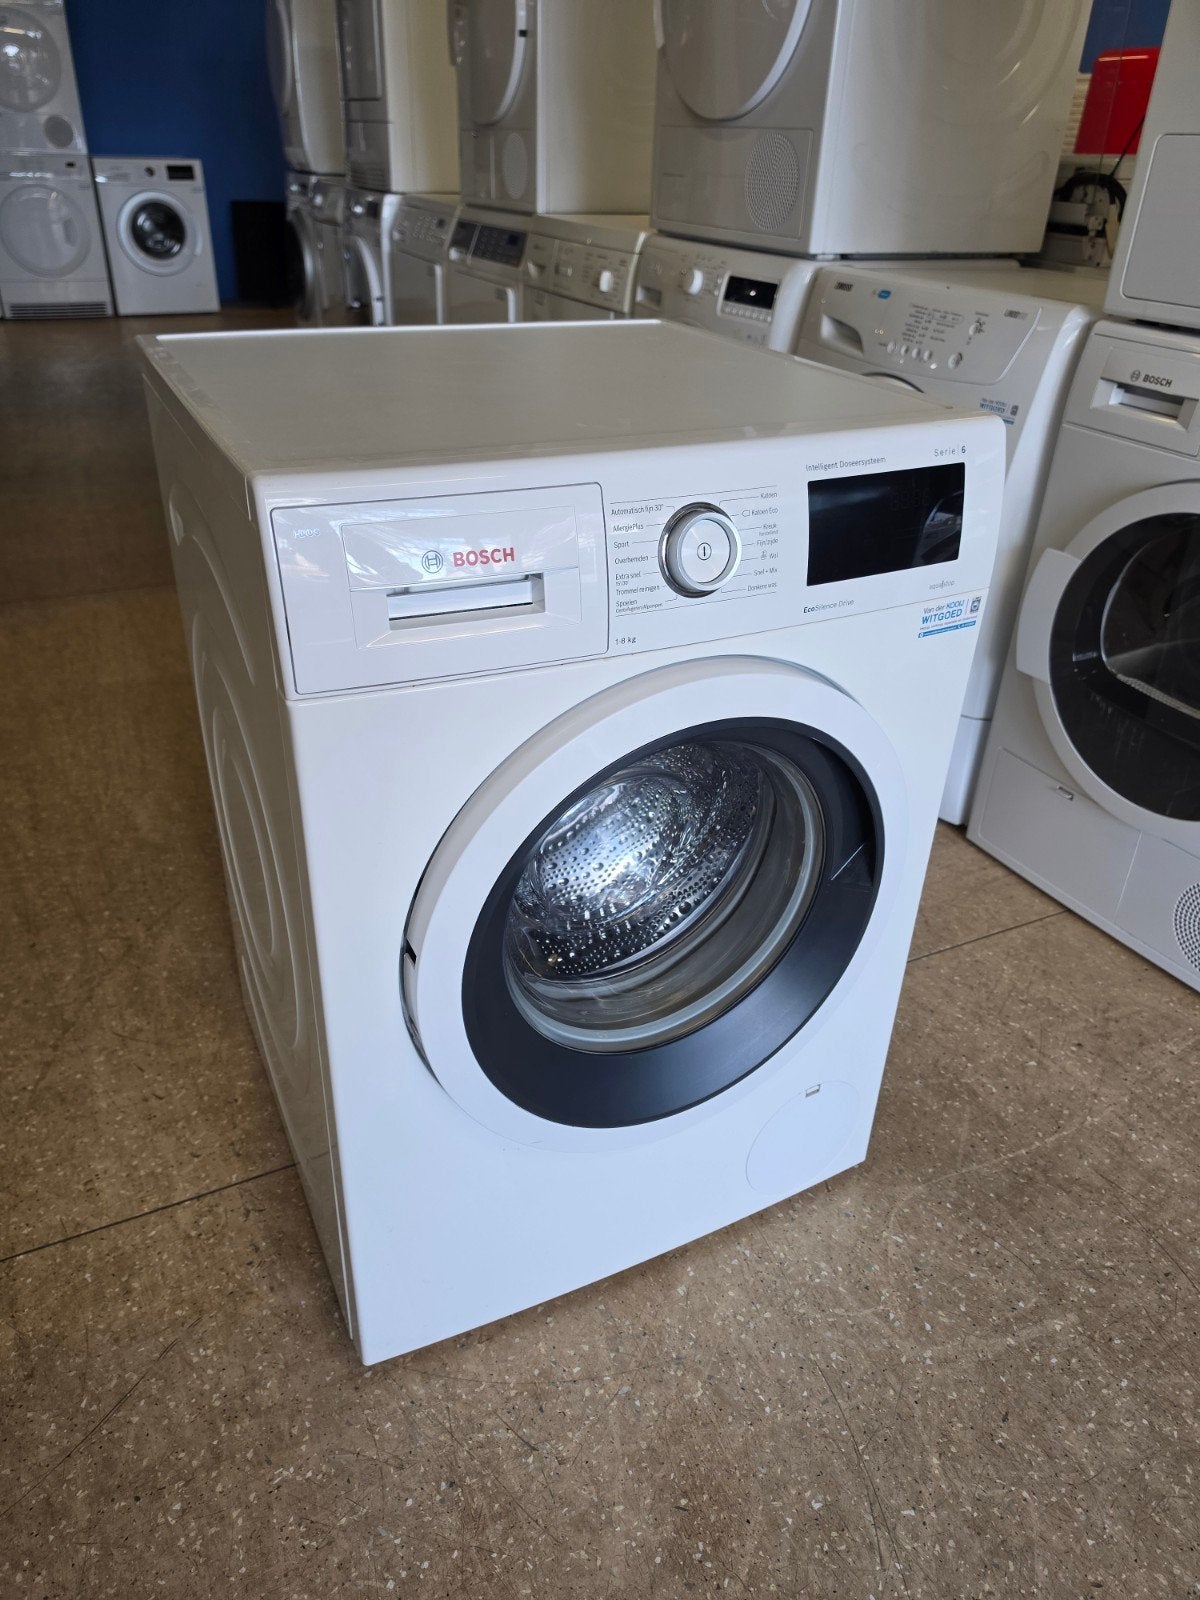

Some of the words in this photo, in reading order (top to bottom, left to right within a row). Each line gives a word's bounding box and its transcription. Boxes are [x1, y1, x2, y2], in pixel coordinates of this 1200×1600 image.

[1142, 374, 1173, 388] BOSCH
[934, 447, 956, 457] Serie
[961, 446, 966, 454] 6
[805, 461, 838, 472] Intelligent
[839, 456, 886, 468] Doseersysteem
[613, 541, 630, 550] Sport
[453, 547, 515, 567] BOSCH
[614, 555, 649, 565] Overhemden
[616, 573, 630, 581] Extra
[616, 587, 638, 596] Trommel
[803, 602, 837, 614] EcoSilence
[838, 598, 855, 608] Drive
[922, 608, 963, 624] WITGOED
[627, 636, 637, 644] kg
